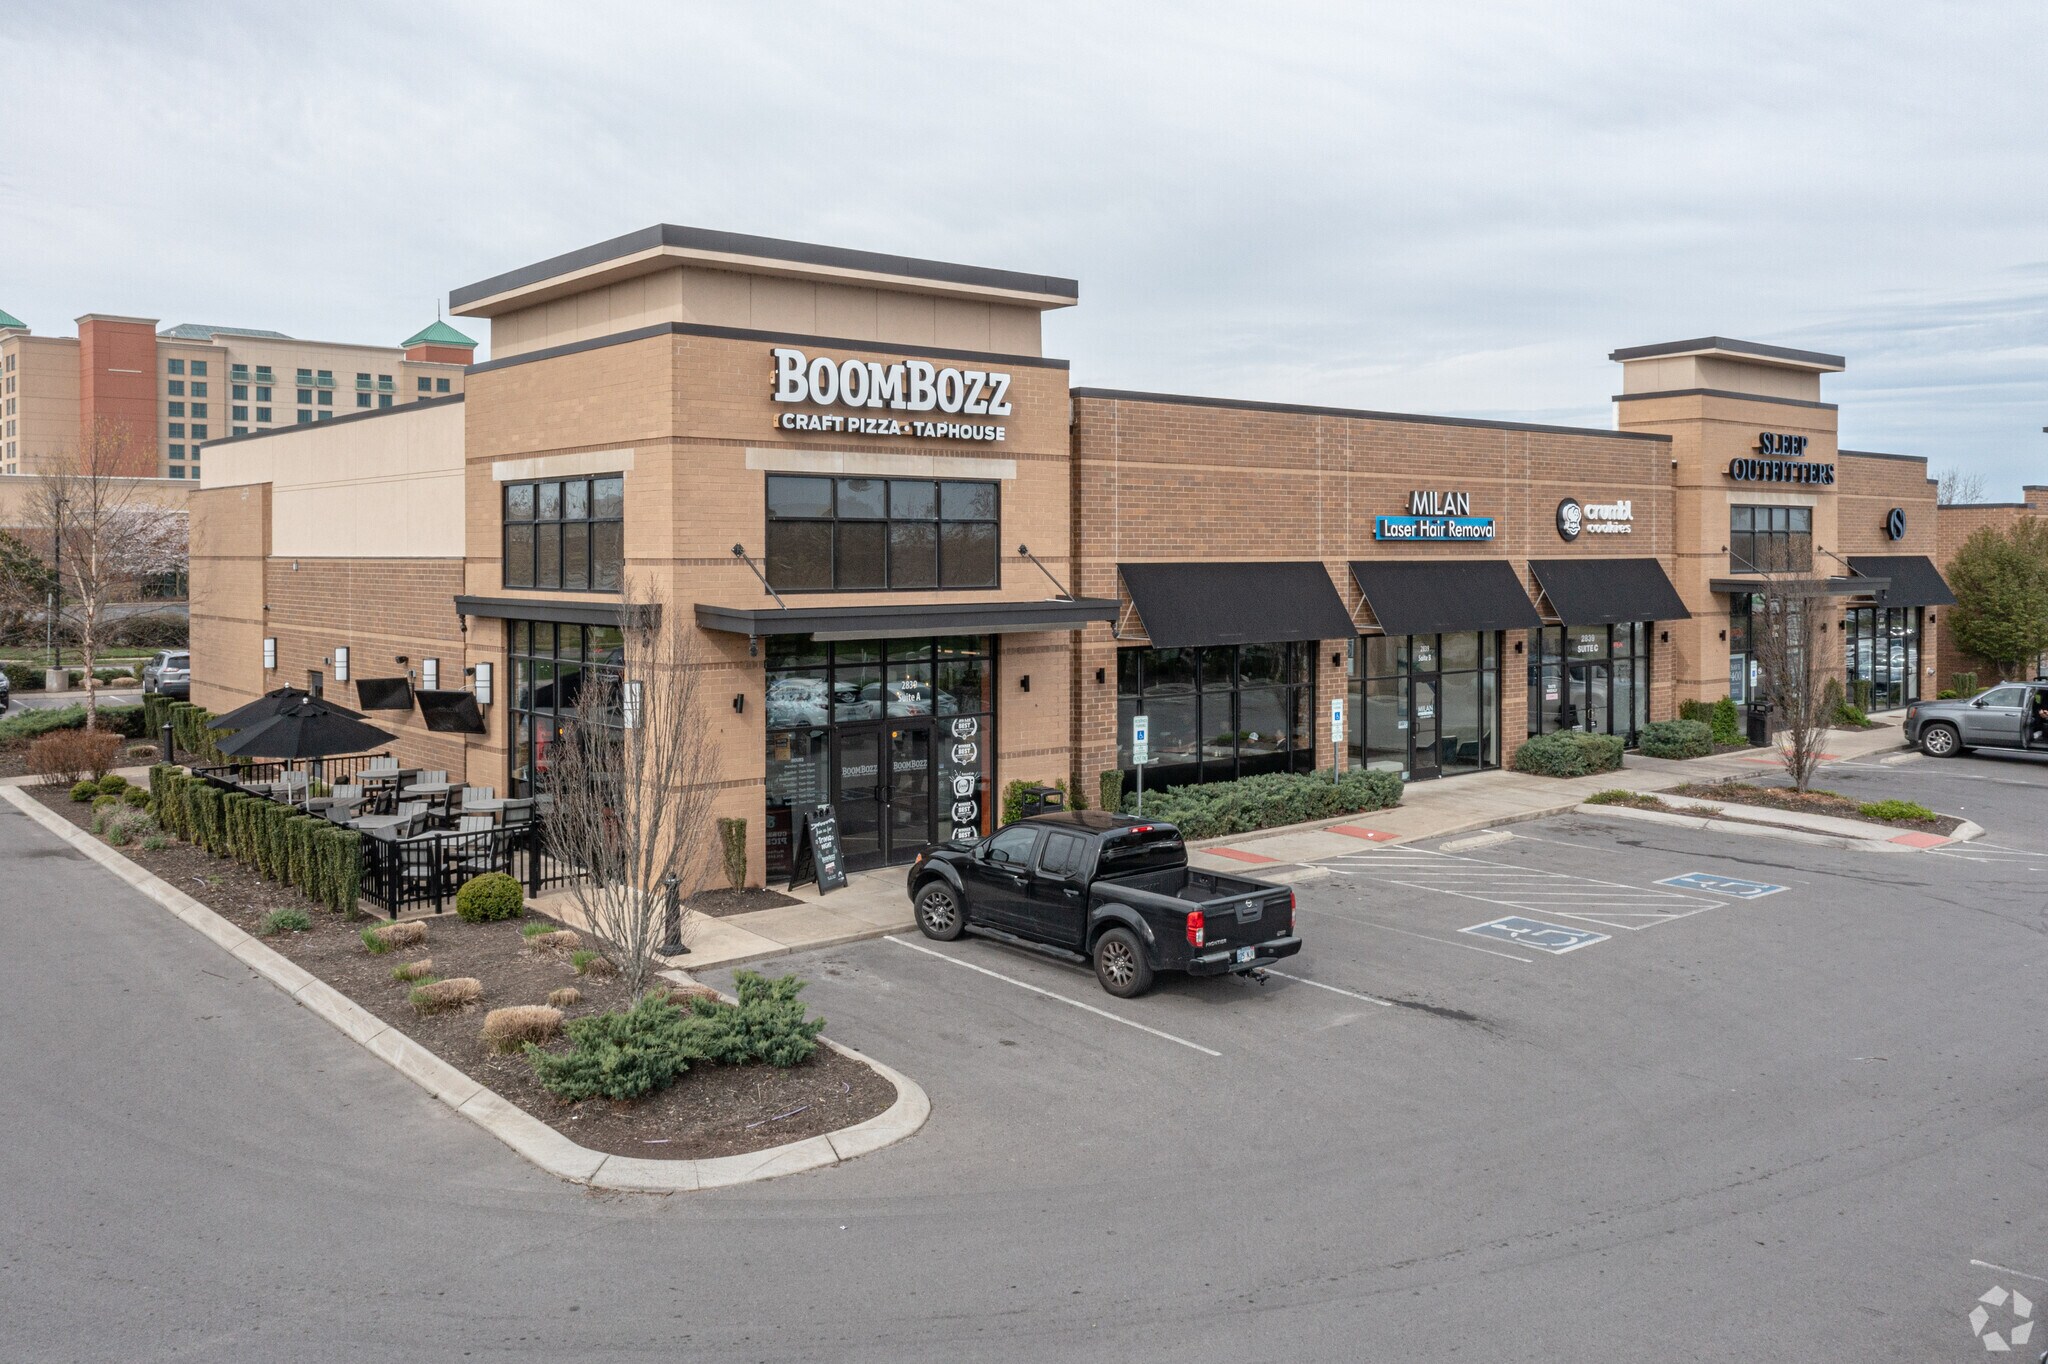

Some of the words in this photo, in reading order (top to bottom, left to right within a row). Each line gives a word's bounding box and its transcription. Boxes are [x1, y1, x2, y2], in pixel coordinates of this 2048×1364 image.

[770, 348, 1012, 416] BOOMBOZZ
[781, 413, 844, 432] CRAFT
[847, 416, 901, 435] PIZZA
[912, 421, 1006, 442] TAPHOUSE
[1761, 432, 1809, 457] SLEEP
[1731, 457, 1836, 485] OUTFITTERS
[1410, 490, 1470, 516] MILAN
[1583, 500, 1634, 521] crumbl
[1383, 519, 1417, 538] Laser
[1420, 520, 1446, 538] Hair
[1449, 520, 1496, 538] Removal
[1586, 521, 1632, 534] cookies
[1577, 645, 1594, 653] SUITE
[1594, 644, 1599, 652] C
[898, 692, 915, 702] Suite
[916, 692, 921, 701] A
[841, 764, 878, 776] BOOMBOZZ
[893, 759, 928, 770] BOOMBOZZ
